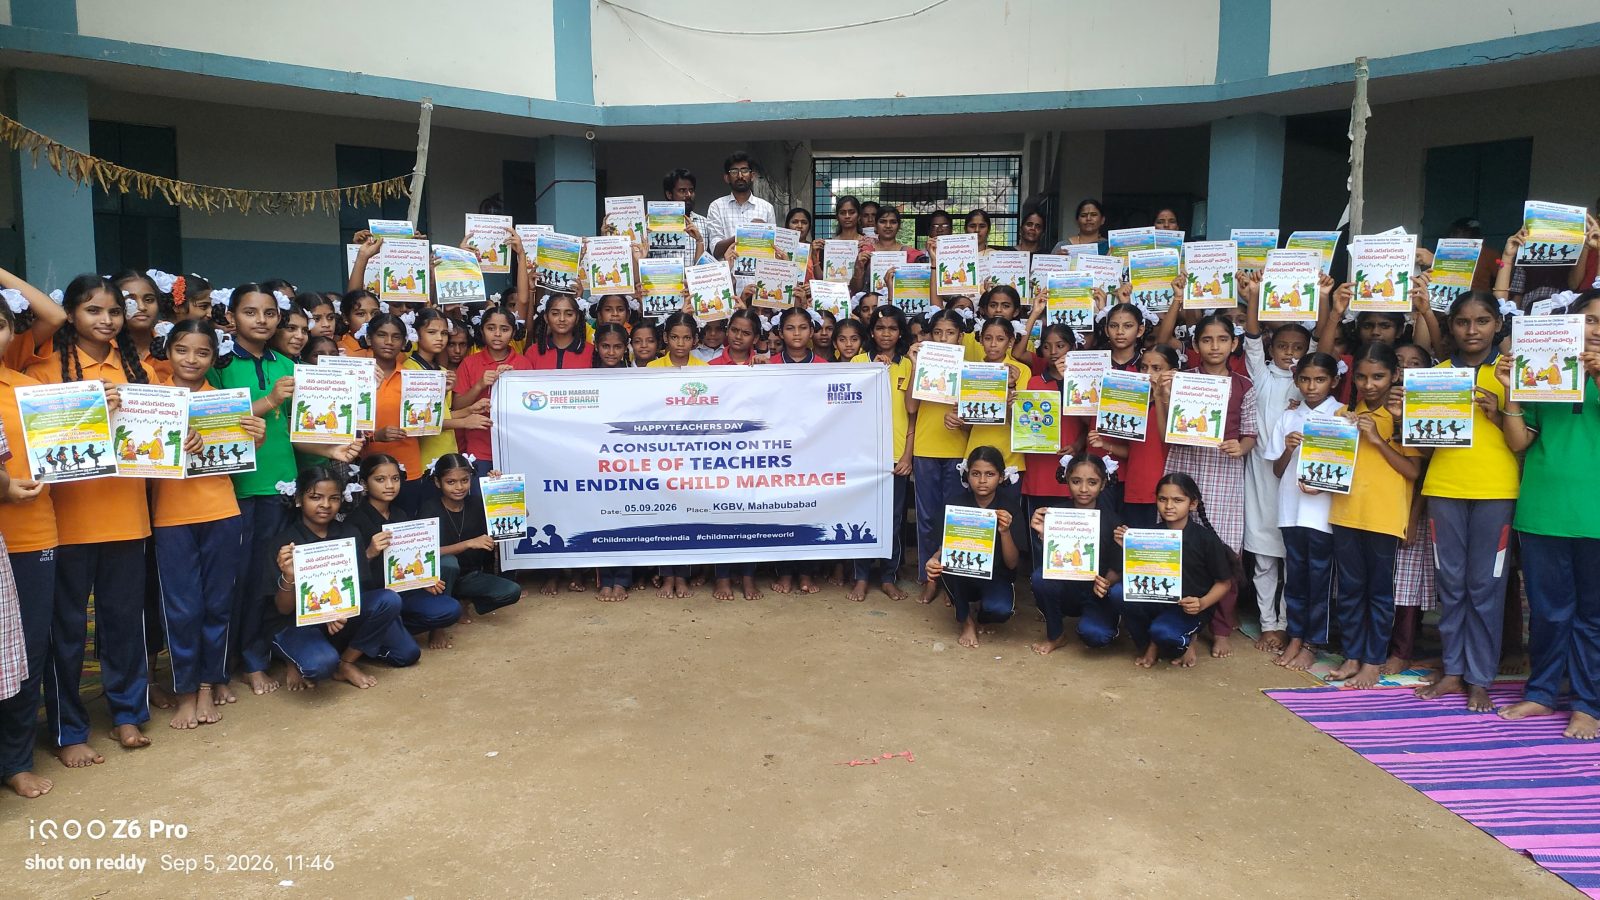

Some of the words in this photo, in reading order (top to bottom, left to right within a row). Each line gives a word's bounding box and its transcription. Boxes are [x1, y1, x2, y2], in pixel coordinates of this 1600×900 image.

[827, 383, 851, 392] JUST
[569, 395, 599, 403] BHARAT
[665, 396, 719, 405] SHARE
[827, 391, 862, 401] RIGHTS
[669, 423, 722, 431] TEACHERS
[724, 422, 743, 430] DAY
[599, 444, 610, 453] A
[613, 440, 732, 453] CONSULTATION
[735, 440, 759, 450] ON
[762, 439, 792, 449] THE
[598, 458, 651, 473] ROLE
[657, 457, 684, 471] OF
[690, 454, 792, 470] TEACHERS
[543, 479, 568, 492] IN
[575, 477, 660, 492] ENDING
[666, 476, 730, 490] CHILD
[736, 472, 846, 488] MARRIAGE
[624, 503, 677, 513] 05.09.2026
[713, 502, 745, 511] KGBV,
[748, 500, 817, 510] Mahabubabad
[592, 535, 690, 544] #Childmarriagefreeindia
[696, 531, 795, 541] #childmarriagefreeworld
